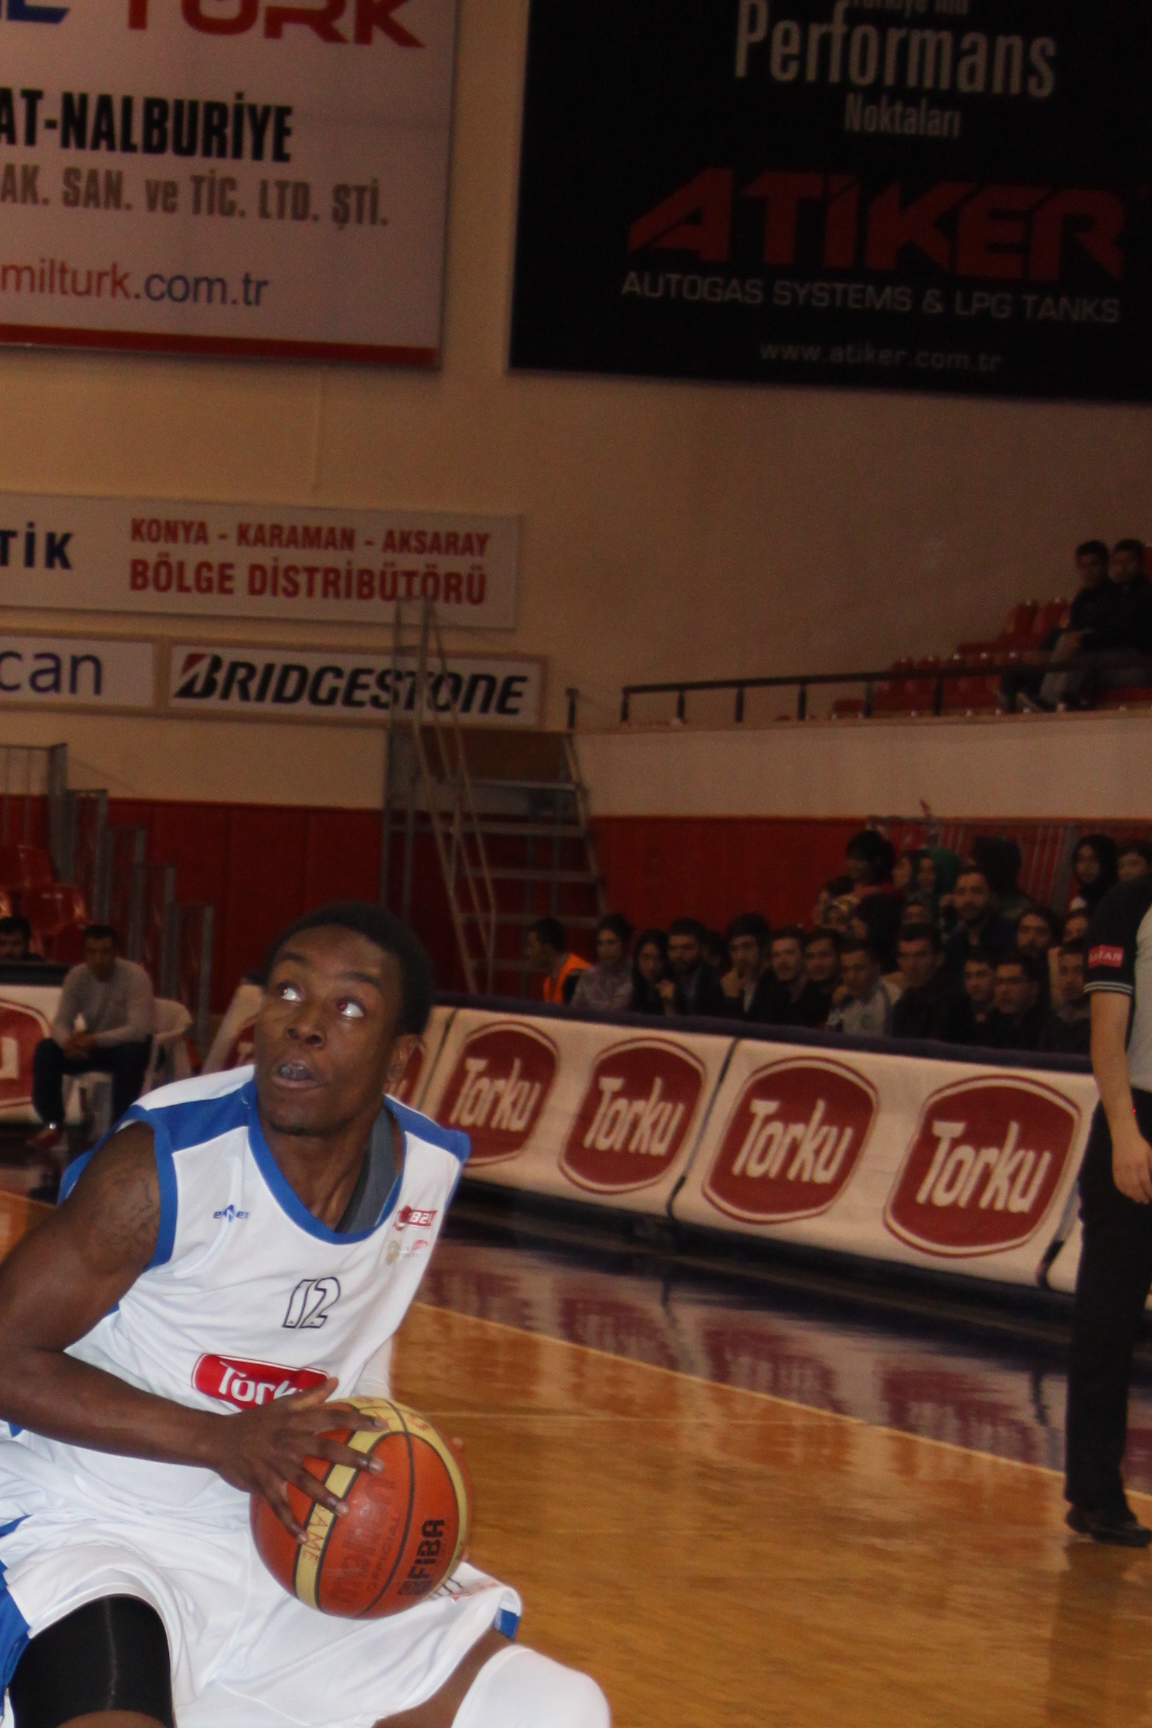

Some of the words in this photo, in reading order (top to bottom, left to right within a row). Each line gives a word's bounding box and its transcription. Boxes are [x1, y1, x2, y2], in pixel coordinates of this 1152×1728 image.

[734, 0, 1058, 99] Performans
[844, 92, 963, 138] Noktaları
[62, 166, 132, 211] SAN.
[145, 179, 177, 214] ve
[191, 168, 246, 218] TİC.
[258, 179, 319, 221] LTD.
[621, 270, 763, 304] AUTOGAS
[772, 279, 911, 313] SYSTEMS
[922, 288, 944, 315] &
[955, 291, 1011, 320] LPG
[1022, 294, 1120, 325] TANKS
[759, 342, 1003, 373] www.atiker.com.tr
[130, 518, 209, 545] KONYA
[236, 522, 356, 551] KARAMAN
[382, 529, 490, 558] AKSARAY
[129, 552, 235, 596] BÖLGE
[248, 556, 487, 605] DİSTRİBÜTÖRÜ
[174, 653, 528, 716] BRIDGESTONE
[449, 1057, 541, 1132] Torku
[583, 1076, 685, 1156] Torku
[732, 1098, 854, 1184] Torku
[915, 1120, 1052, 1213] Torku
[282, 1276, 341, 1329] 12
[219, 1361, 304, 1405] Tork
[409, 1518, 445, 1581] FIBA
